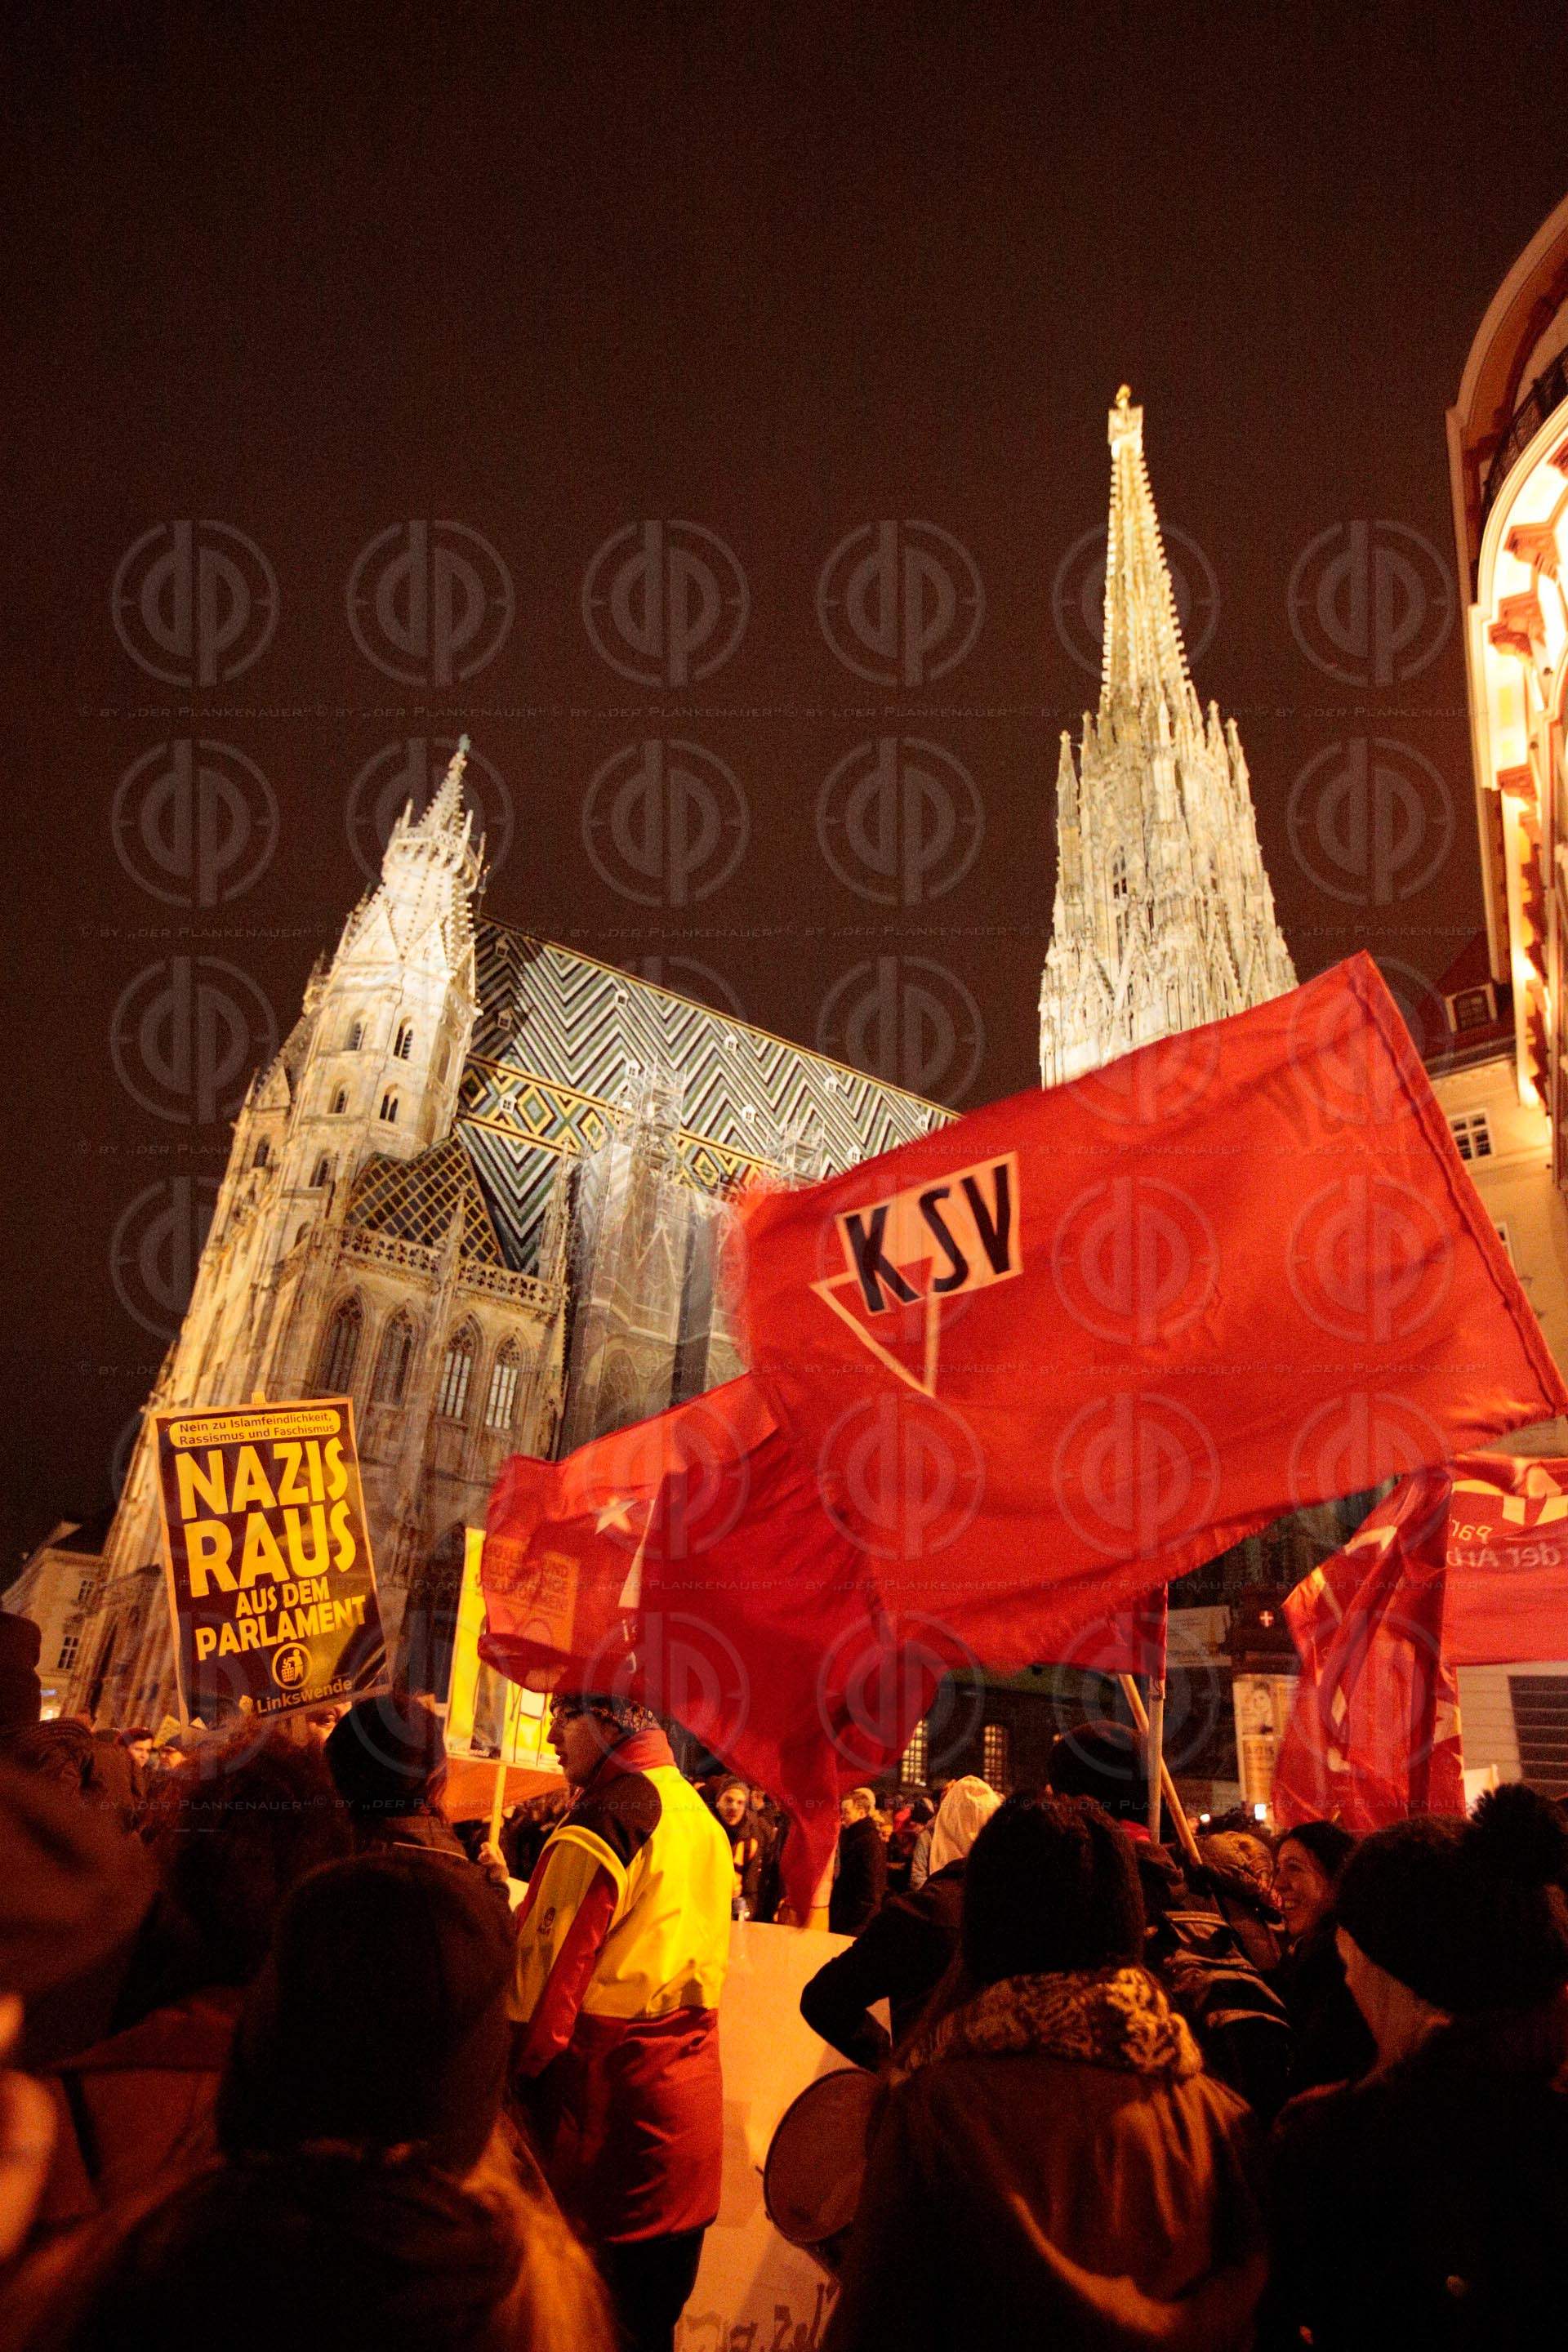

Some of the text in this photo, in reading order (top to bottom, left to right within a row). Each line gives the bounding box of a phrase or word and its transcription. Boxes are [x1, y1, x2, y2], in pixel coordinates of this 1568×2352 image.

[845, 1164, 1011, 1312] KSV
[180, 1412, 332, 1433] Nein zu Islamfeindlichkeit,
[180, 1423, 335, 1445] Rassismus und Faschismus
[175, 1437, 348, 1519] NAZIS
[184, 1500, 357, 1597] RAUS
[235, 1576, 330, 1618] AUS DEM
[195, 1595, 367, 1661] PARLAMENT
[256, 1678, 353, 1714] Linkswende
